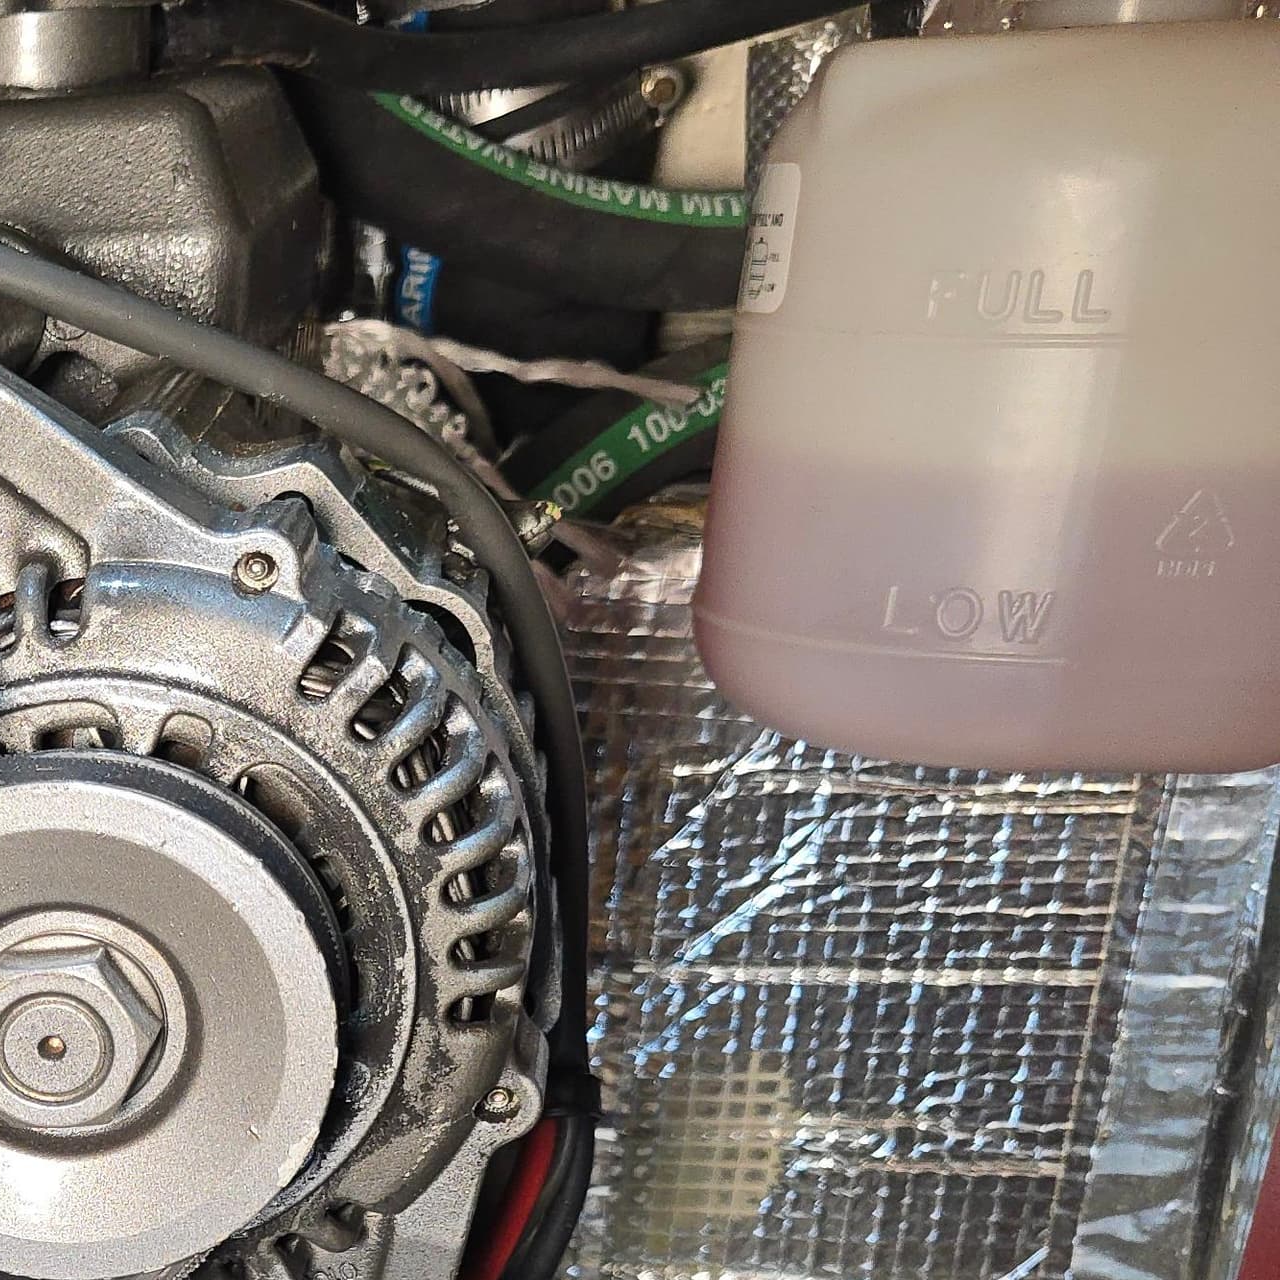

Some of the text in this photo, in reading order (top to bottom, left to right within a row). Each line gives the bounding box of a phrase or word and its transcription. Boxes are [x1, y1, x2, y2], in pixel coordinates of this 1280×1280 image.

[526, 160, 671, 213] MARINE
[926, 268, 1112, 324] FULL
[881, 585, 1057, 645] LOW
